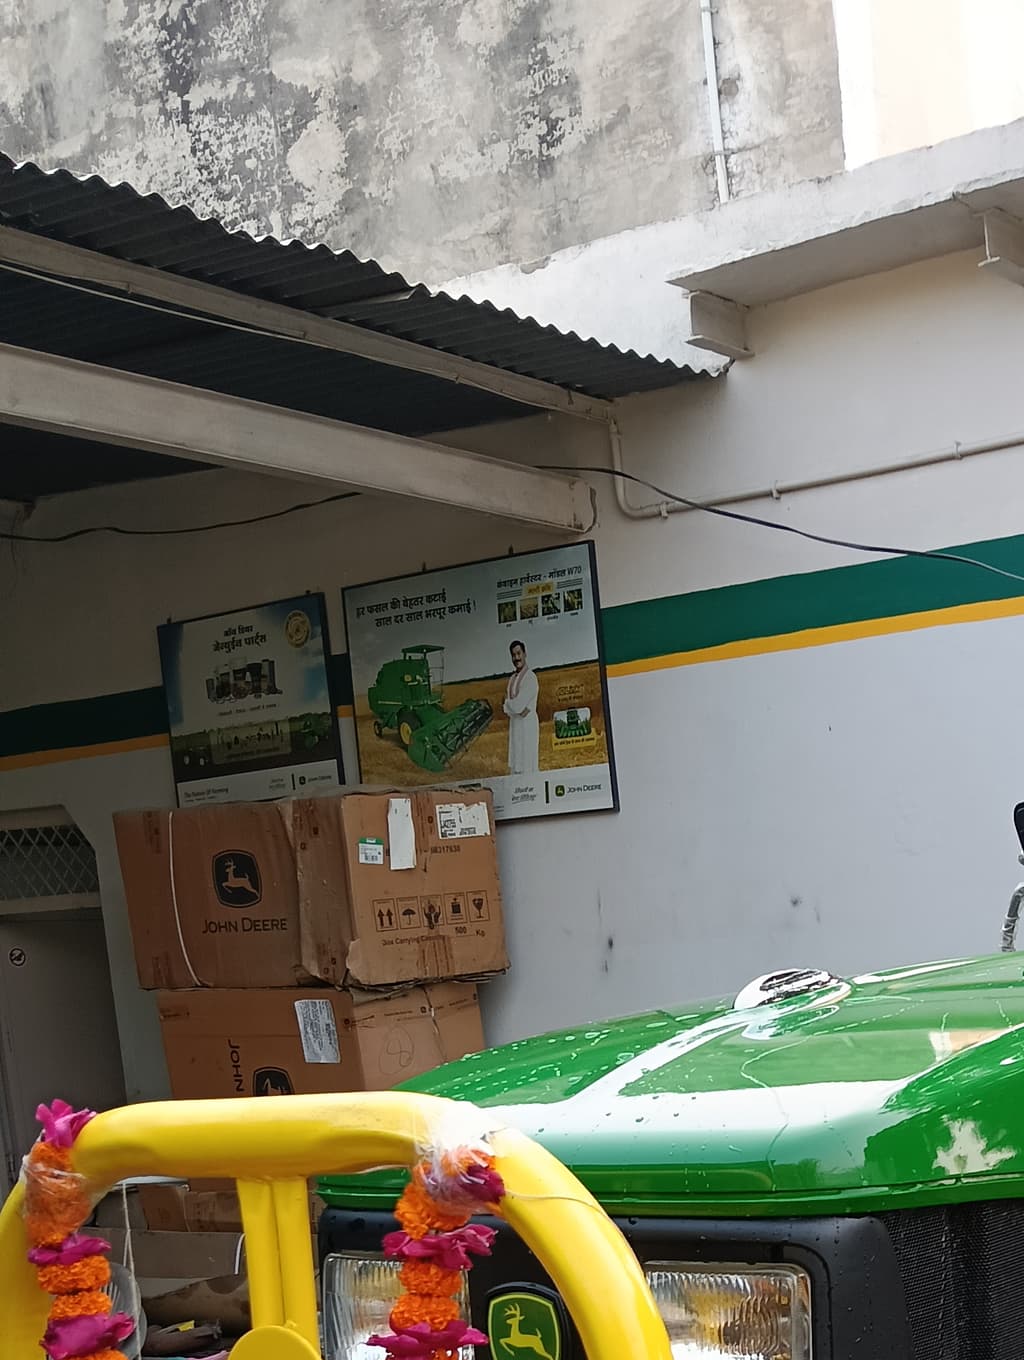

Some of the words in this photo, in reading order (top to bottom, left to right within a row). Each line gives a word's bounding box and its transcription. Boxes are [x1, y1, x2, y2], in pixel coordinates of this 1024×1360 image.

[567, 565, 582, 576] W70
[367, 602, 389, 615] फसल
[390, 598, 401, 611] की
[402, 596, 424, 610] बेहतर
[425, 588, 447, 605] कटाई
[375, 616, 393, 628] साल
[394, 615, 404, 625] दर
[406, 611, 424, 623] साल
[425, 606, 447, 621] भरपूर
[202, 919, 239, 934] JOHN
[241, 917, 288, 932] DEERE
[394, 936, 420, 946] Carrying
[227, 1039, 245, 1092] JOHN
